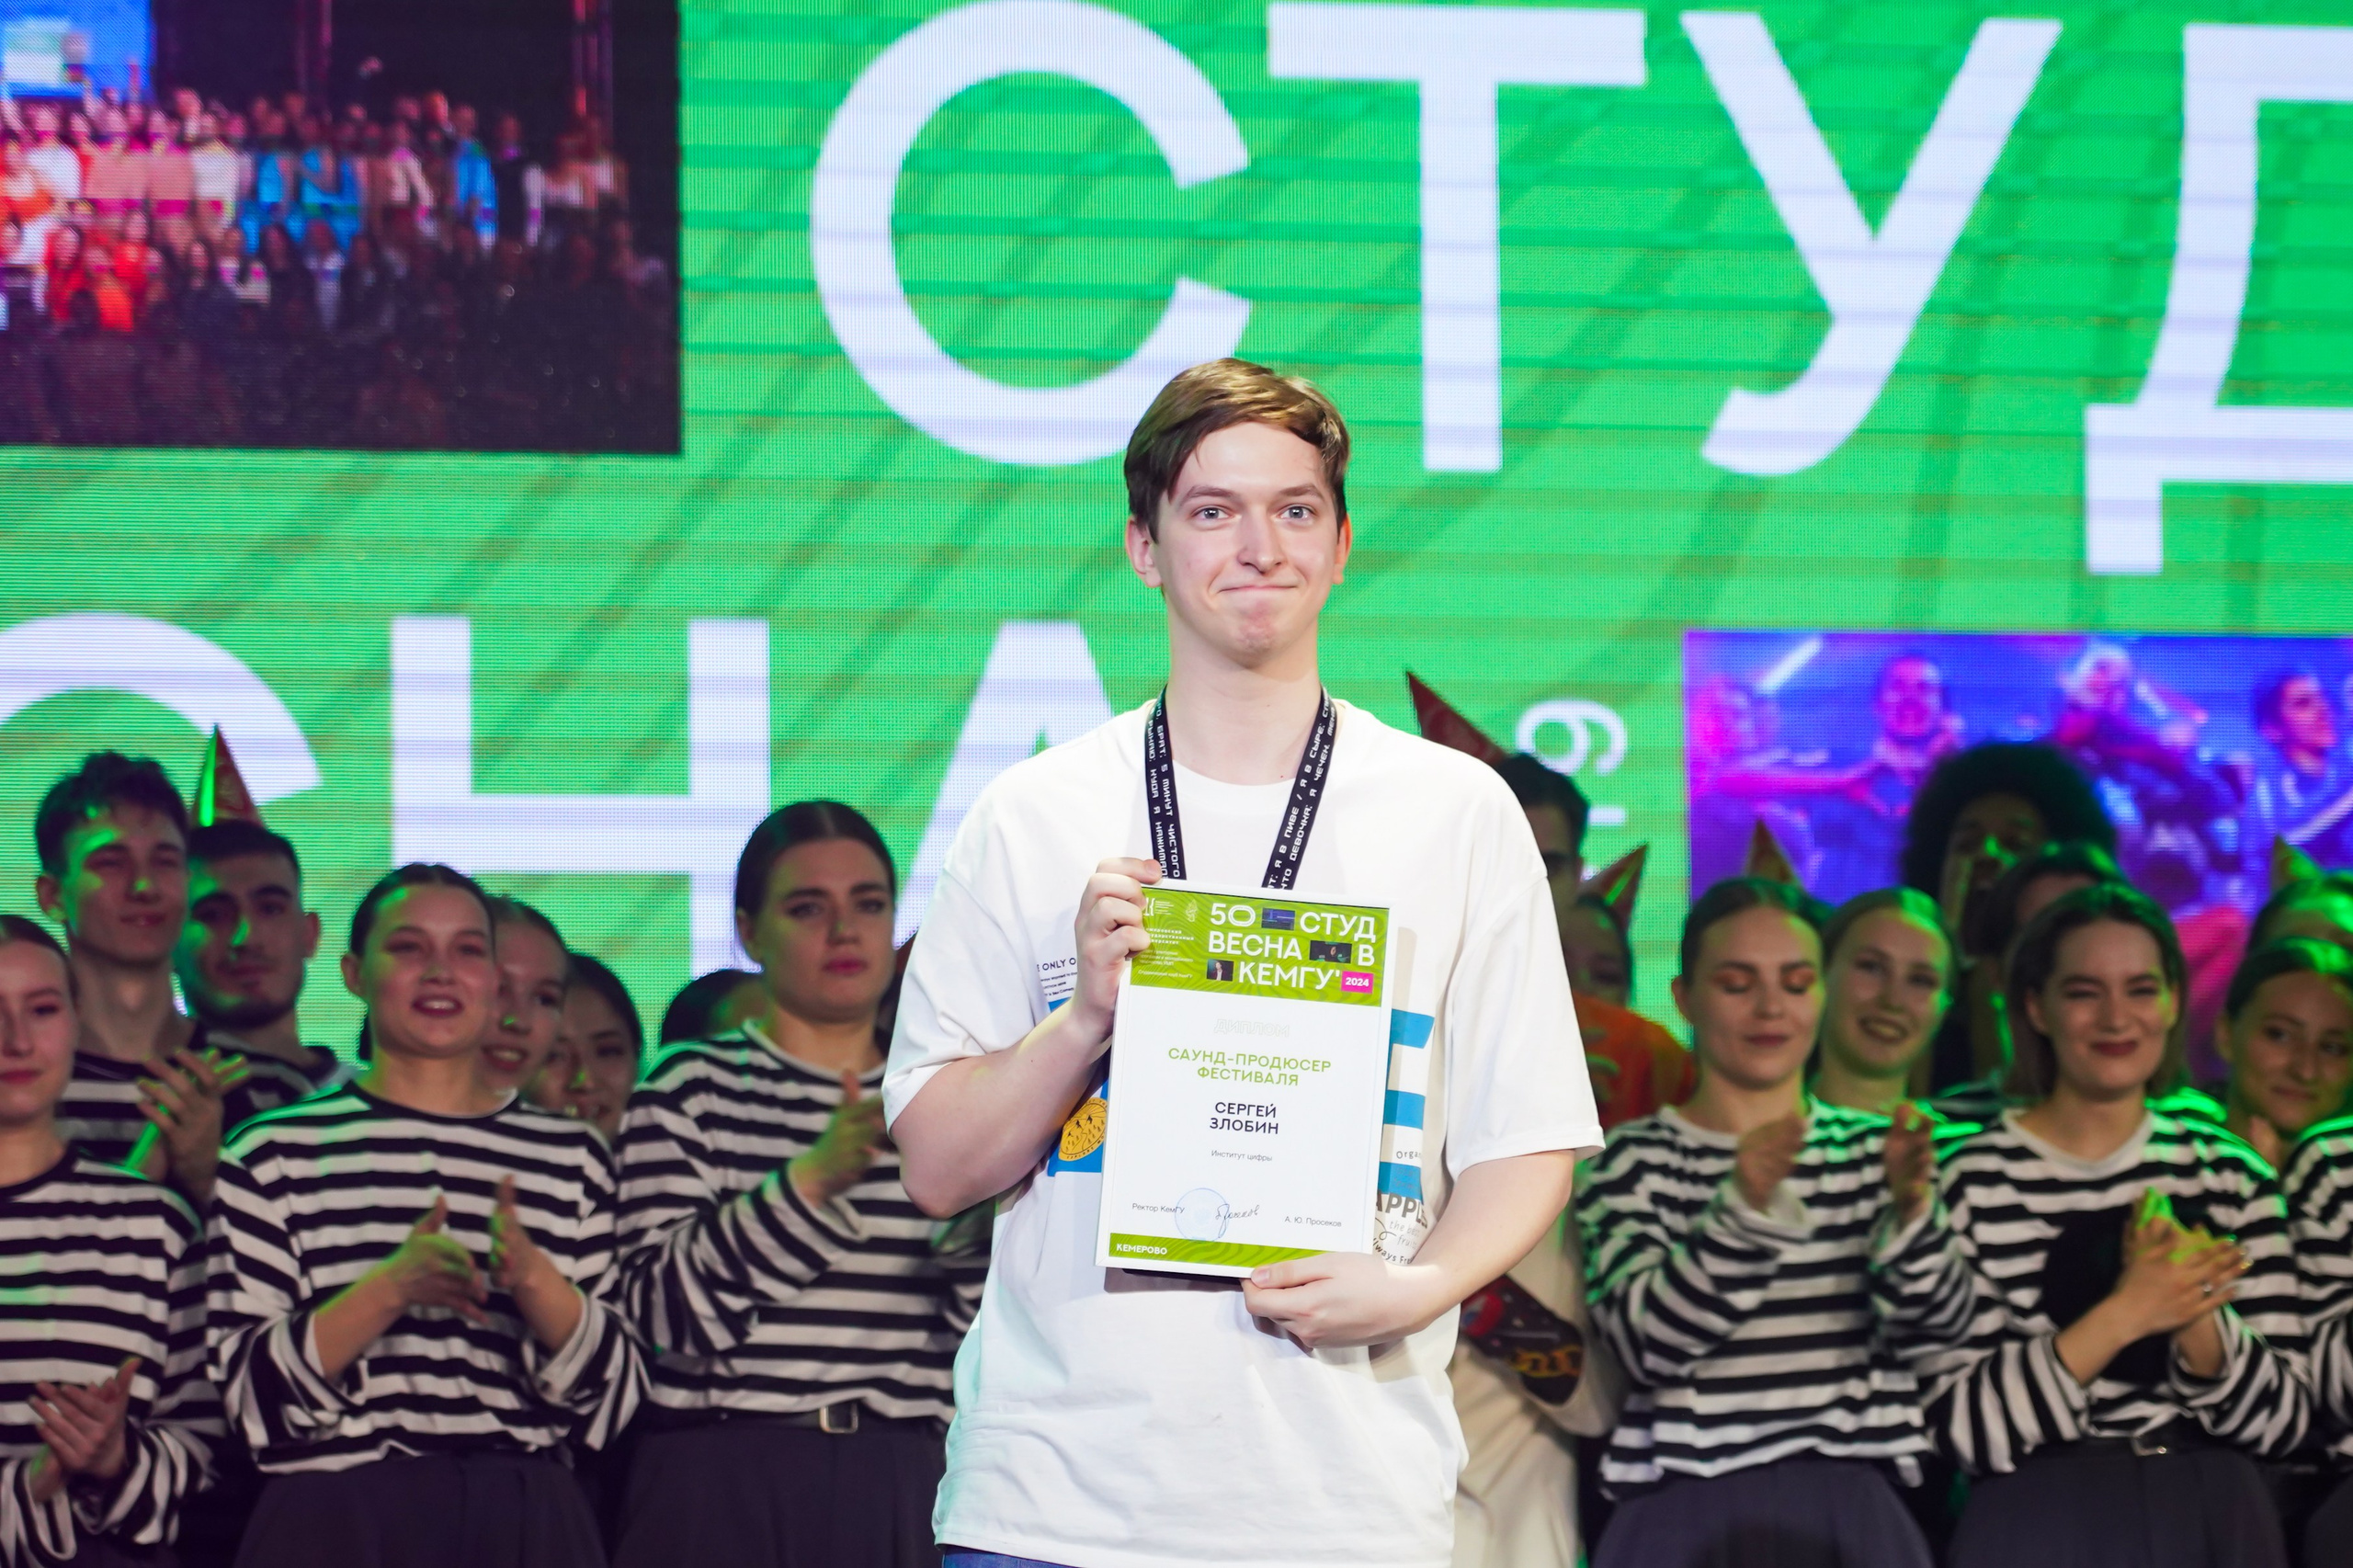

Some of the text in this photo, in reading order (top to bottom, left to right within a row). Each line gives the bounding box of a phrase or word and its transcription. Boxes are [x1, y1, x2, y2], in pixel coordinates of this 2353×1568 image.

[1150, 768, 1159, 799] КУДА
[1309, 789, 1317, 797] Я
[1163, 778, 1174, 816] МИНУТ
[1154, 806, 1161, 814] Я
[1274, 859, 1282, 868] Я
[1279, 845, 1287, 854] В
[1283, 806, 1300, 838] ПИВЕ
[1300, 778, 1308, 788] Я
[1304, 764, 1313, 773] В
[1168, 824, 1180, 878] ЧИСТОГО
[1210, 903, 1377, 943] 50 СТУД
[1208, 931, 1375, 966] ВЕСНА В
[1042, 959, 1066, 971] ONLY
[1239, 961, 1370, 990] КЕМГУ' 2024
[1213, 1018, 1290, 1038] ДИПЛОМ
[1168, 1048, 1331, 1073] САУНД-ПРОДЮСЕР
[1197, 1066, 1299, 1086] ФЕСТИВАЛЯ
[1214, 1101, 1277, 1119] СЕРГЕЙ
[1210, 1118, 1279, 1134] ЗЛОБИН
[1211, 1150, 1273, 1162] Институт цифры
[1131, 1202, 1185, 1214] Ректор КемГУ
[1305, 1217, 1342, 1227] Просеков
[1116, 1244, 1168, 1255] КЕМЕРОВО
